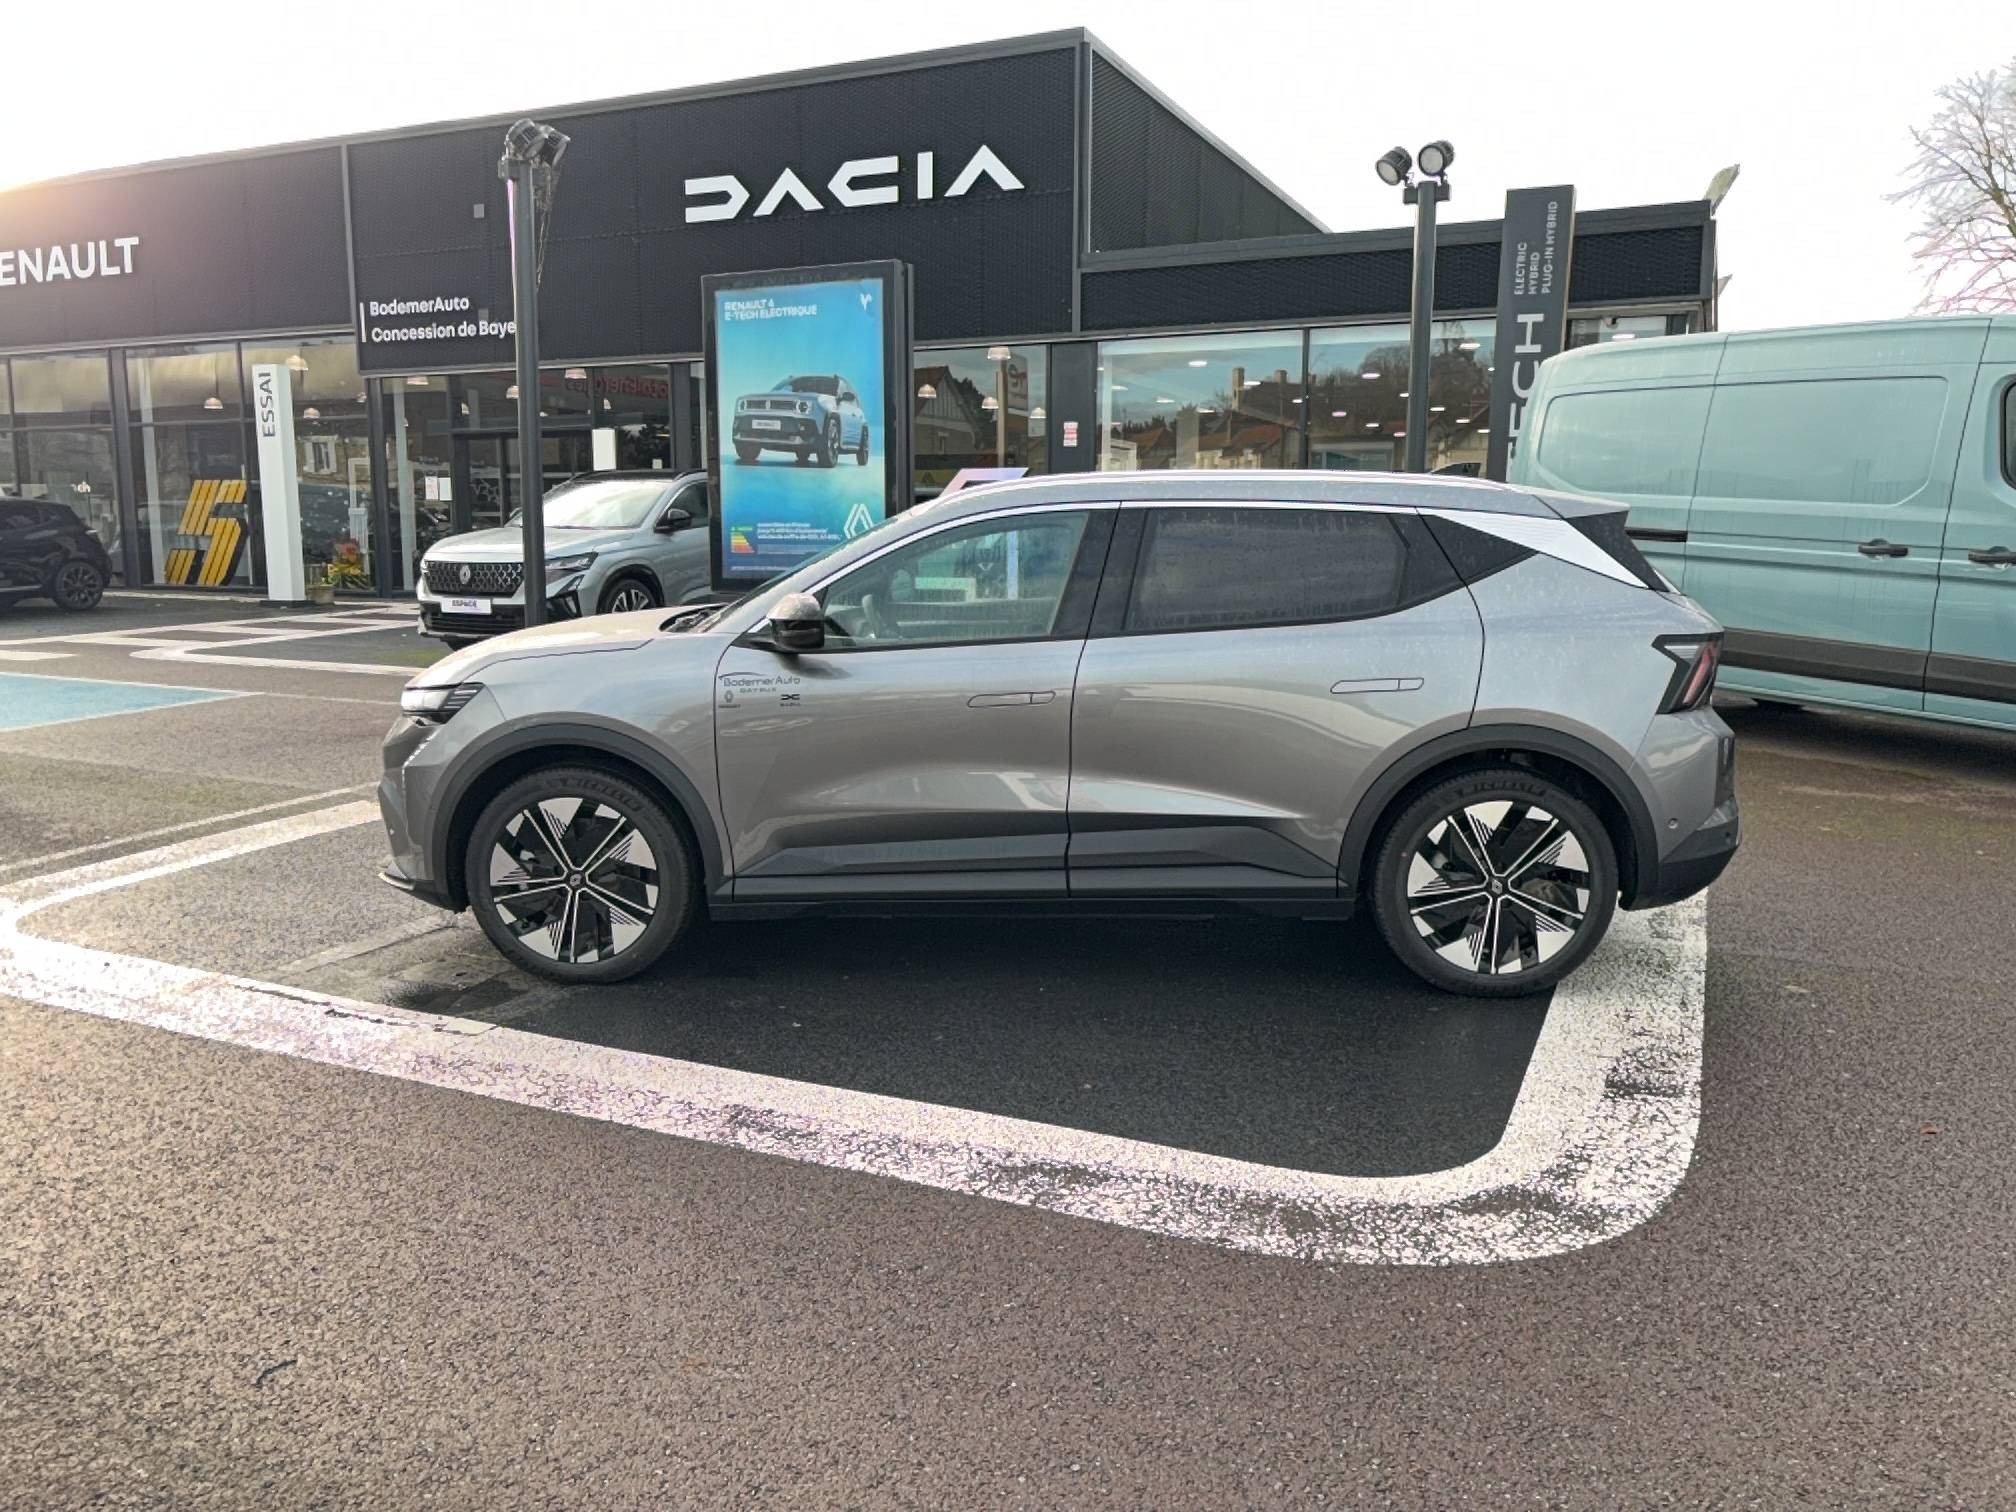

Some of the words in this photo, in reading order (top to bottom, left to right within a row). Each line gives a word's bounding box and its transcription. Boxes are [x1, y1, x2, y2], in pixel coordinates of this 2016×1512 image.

[685, 144, 1025, 223] DACIA
[1546, 201, 1559, 245] HYBRID
[1514, 242, 1528, 295] ELECTRIC
[1528, 252, 1541, 295] HYBRID
[1541, 247, 1555, 294] PLUG-IN
[369, 297, 470, 316] BodemerAuto
[724, 299, 767, 311] RENAULT
[371, 322, 455, 343] Concession
[457, 320, 477, 338] de
[258, 372, 276, 438] ESSAI
